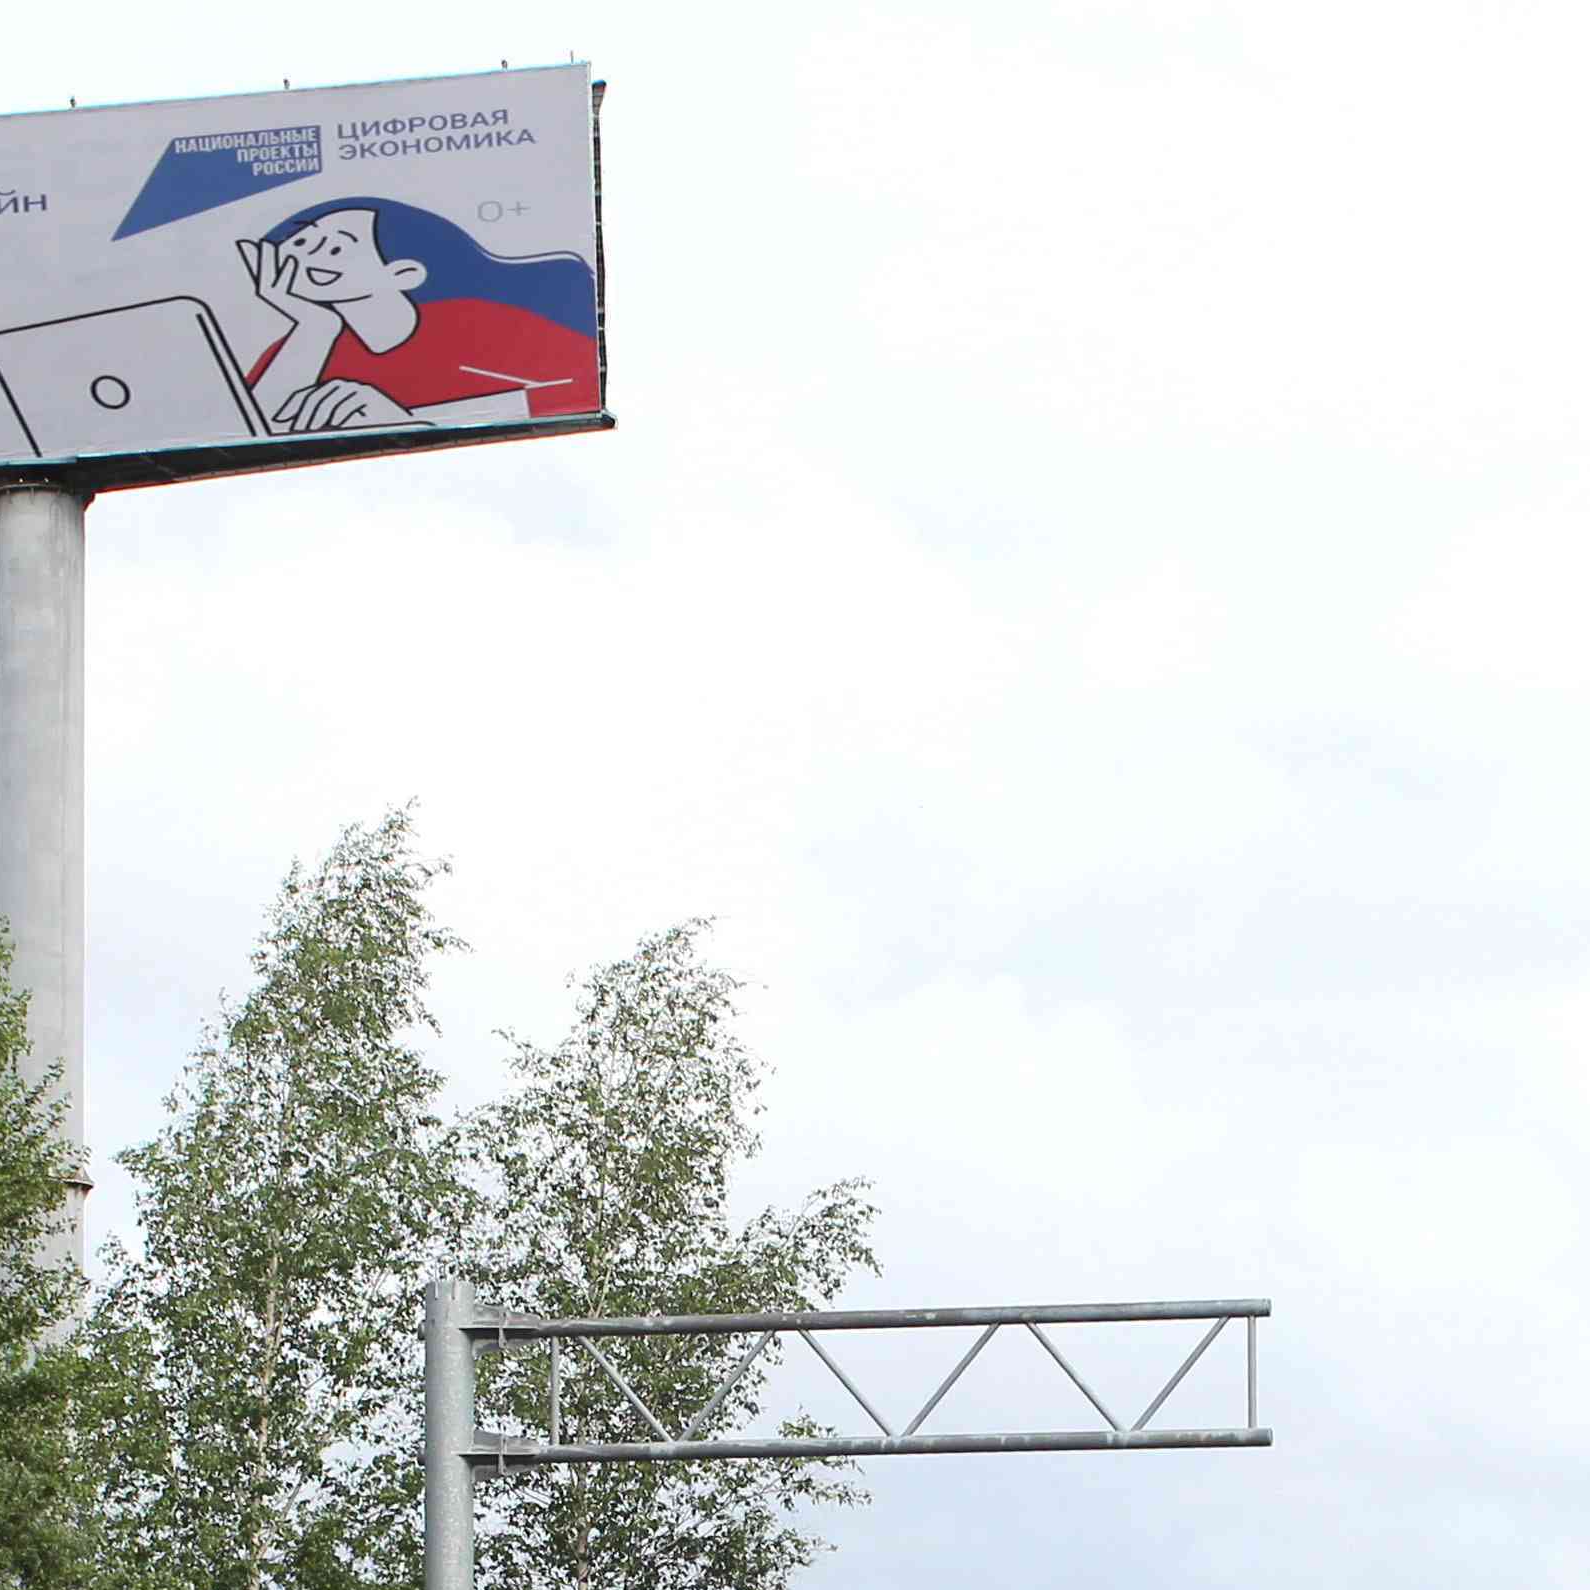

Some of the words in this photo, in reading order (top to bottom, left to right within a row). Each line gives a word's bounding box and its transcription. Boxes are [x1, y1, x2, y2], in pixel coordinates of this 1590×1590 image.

[337, 109, 509, 142] ЦИФРОВАЯ
[174, 127, 318, 156] НАЦИОНАЛЬНЫЕ
[236, 142, 318, 164] ПРОЕКТЫ
[339, 128, 537, 161] ЭКОНОМИКА
[252, 157, 320, 177] РОССИИ
